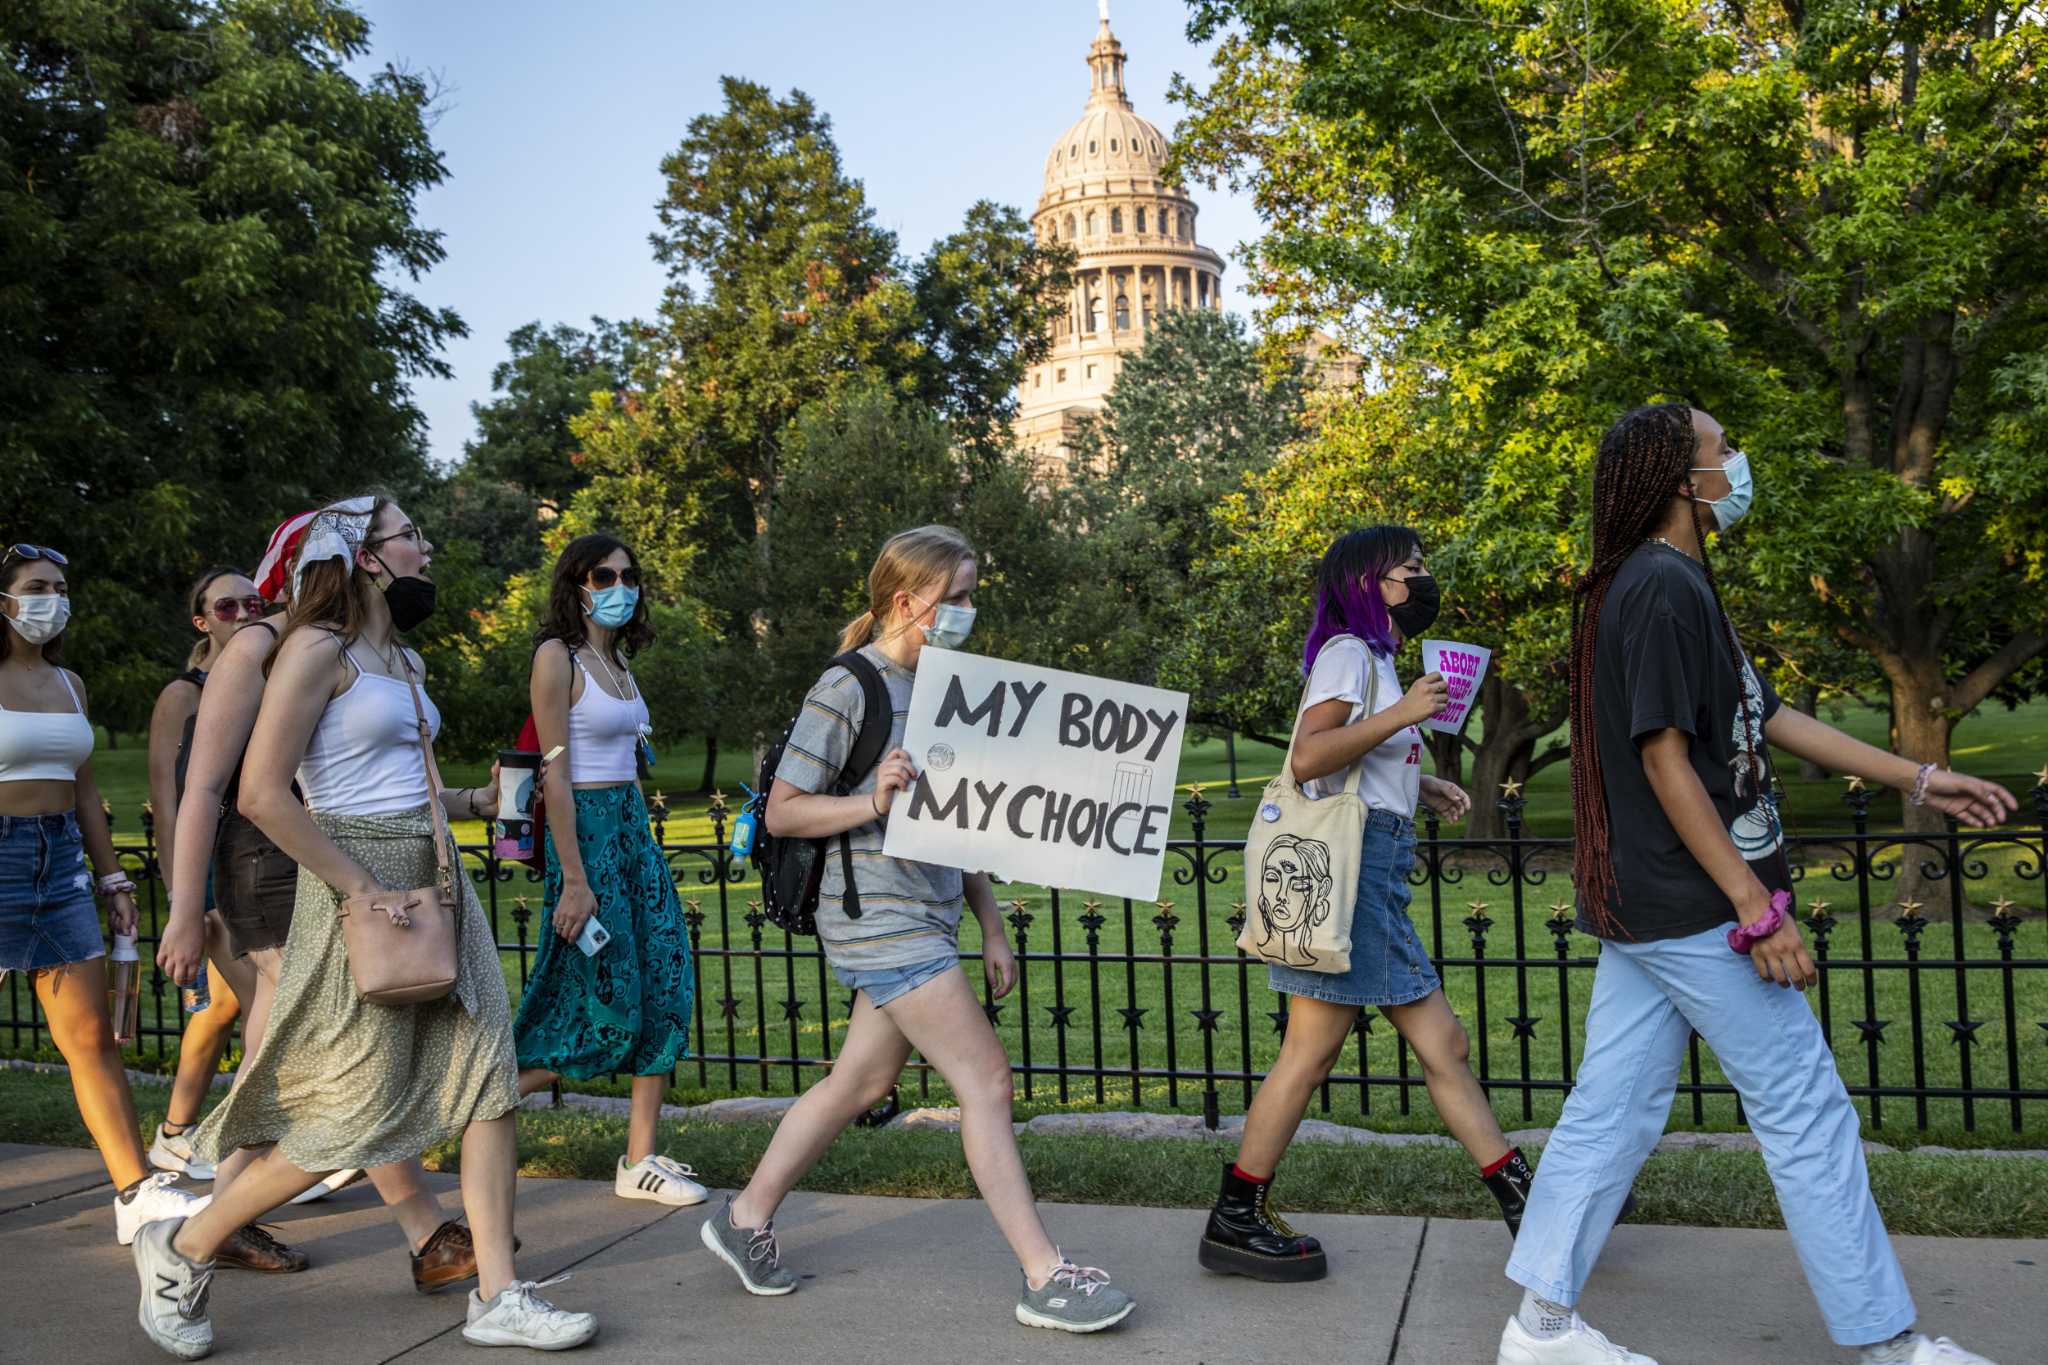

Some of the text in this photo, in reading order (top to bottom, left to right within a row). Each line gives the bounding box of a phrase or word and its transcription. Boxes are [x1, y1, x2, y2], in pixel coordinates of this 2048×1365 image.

[1440, 650, 1481, 677] ABORT
[934, 674, 1178, 761] MY BODY
[907, 769, 1168, 856] MY CHOICE
